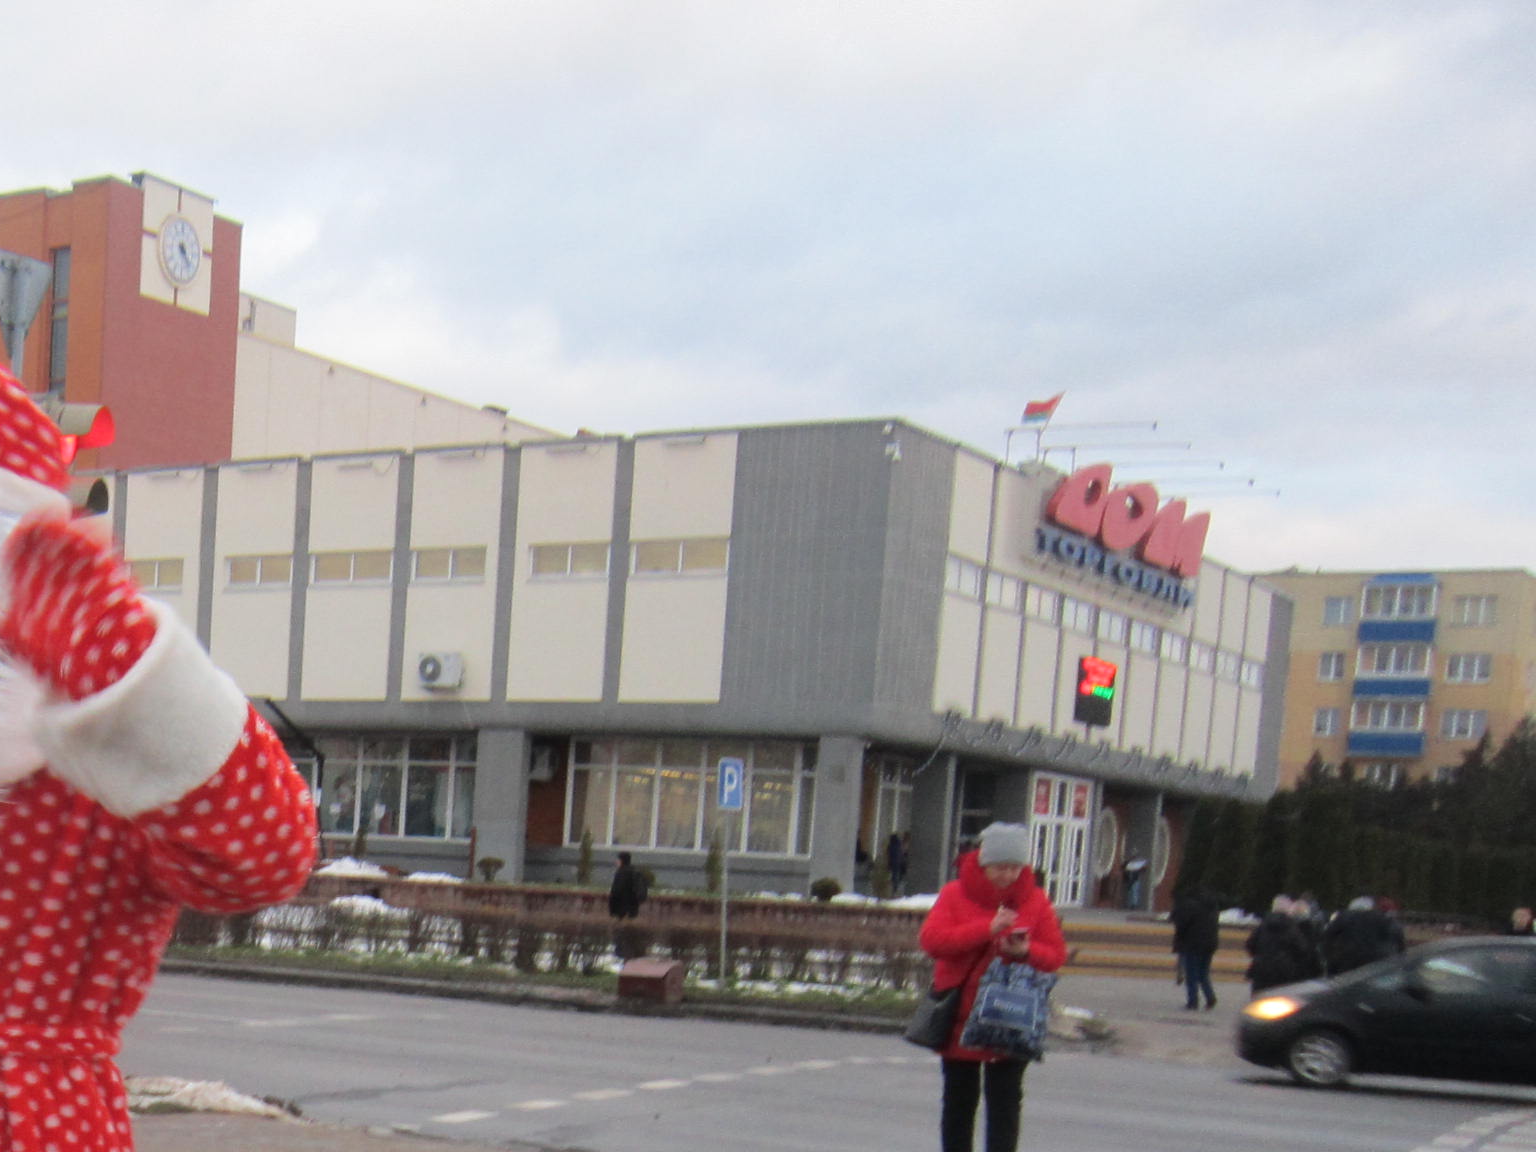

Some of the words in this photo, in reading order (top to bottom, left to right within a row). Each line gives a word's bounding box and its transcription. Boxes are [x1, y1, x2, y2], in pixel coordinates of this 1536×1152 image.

[1046, 463, 1211, 579] ДОМ
[1035, 527, 1196, 609] ТОРГОВЛИ
[724, 766, 738, 805] P
